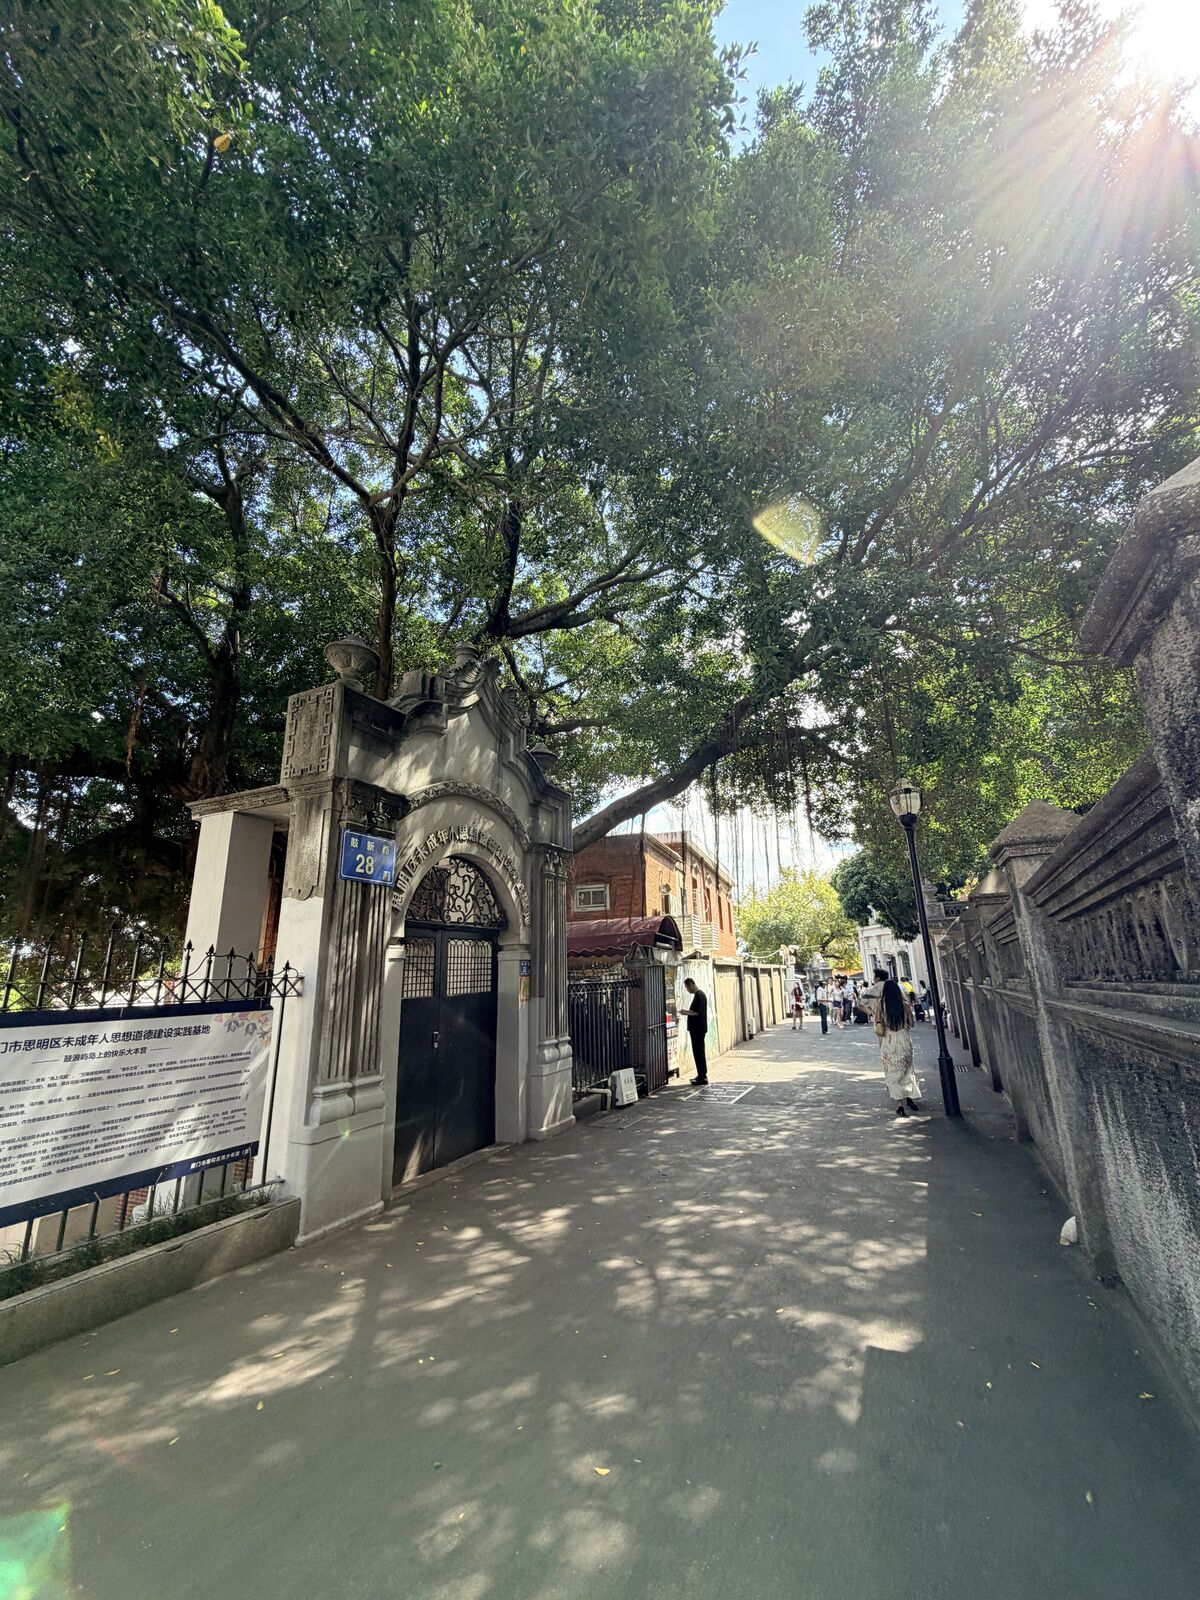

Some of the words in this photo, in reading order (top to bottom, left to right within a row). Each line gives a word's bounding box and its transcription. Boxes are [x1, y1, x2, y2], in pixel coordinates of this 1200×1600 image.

[350, 837, 389, 855] 鼓新路
[356, 853, 375, 875] 28
[63, 1046, 148, 1063] 鼓浪屿岛上的快乐大本营
